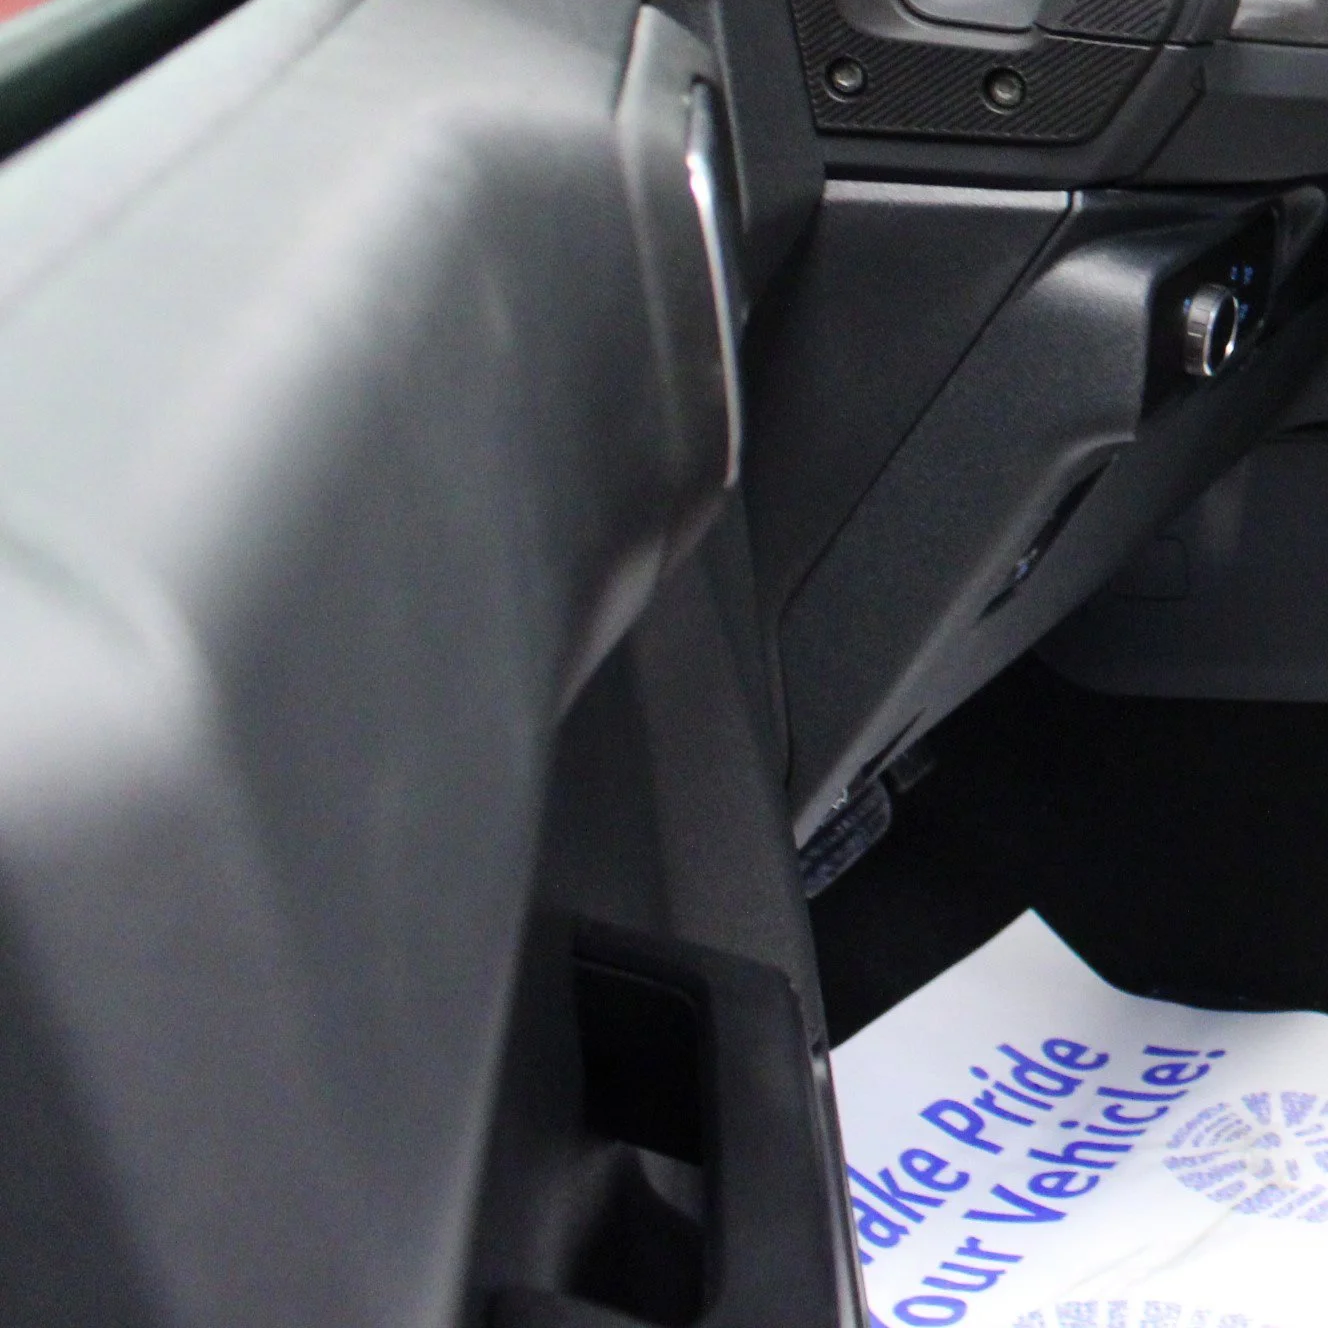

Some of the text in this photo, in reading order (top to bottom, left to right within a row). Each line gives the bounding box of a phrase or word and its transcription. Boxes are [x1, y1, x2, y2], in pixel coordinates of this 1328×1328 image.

[847, 1038, 1109, 1265] ake Pride
[869, 1044, 1227, 1328] our Vehicle!
